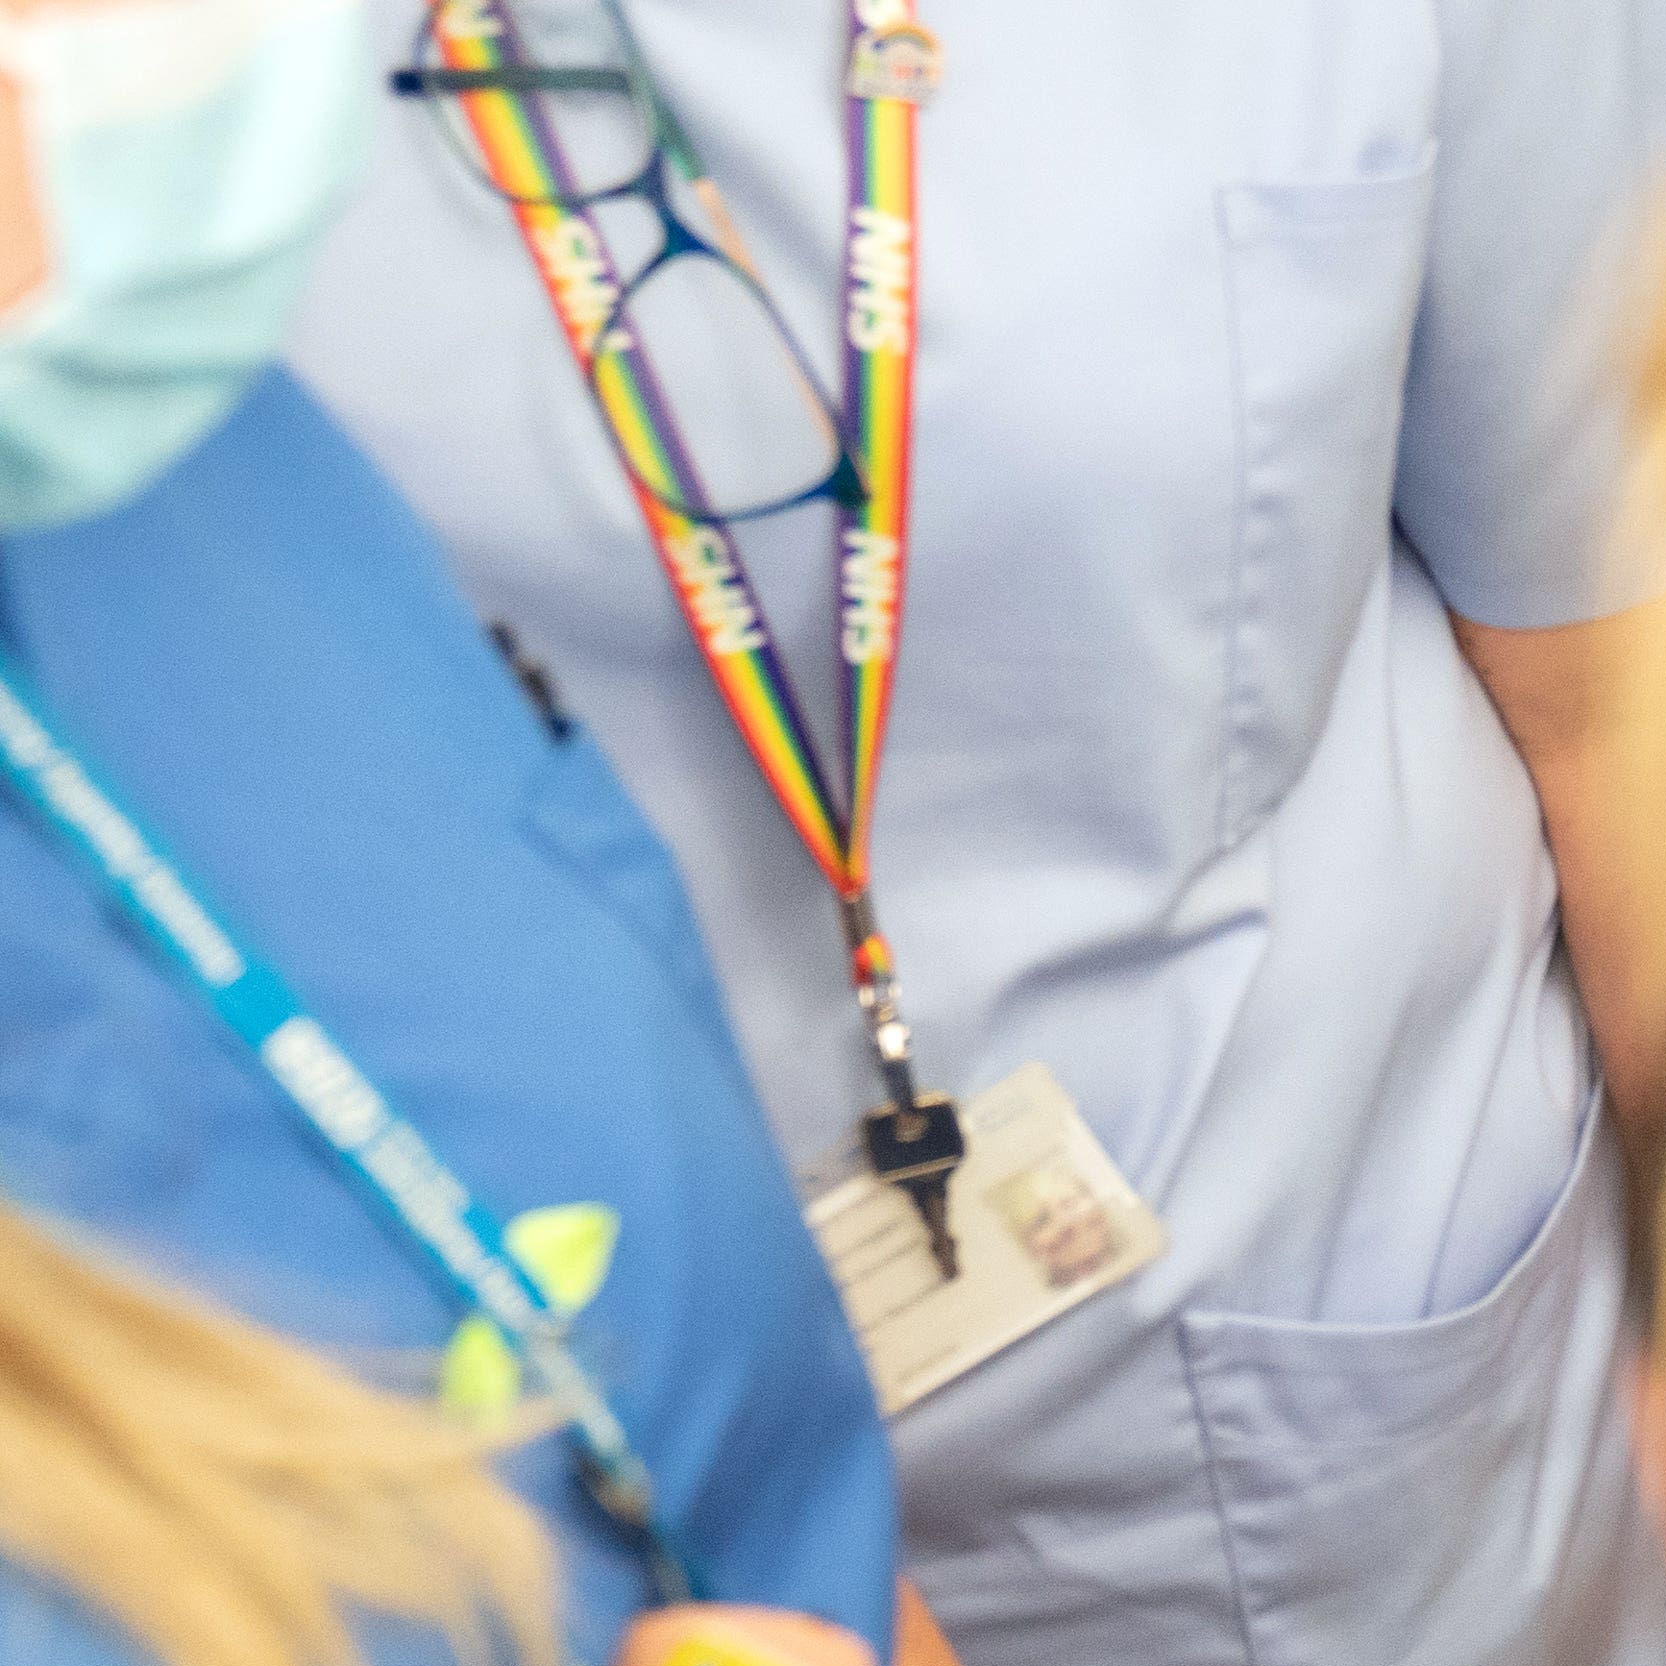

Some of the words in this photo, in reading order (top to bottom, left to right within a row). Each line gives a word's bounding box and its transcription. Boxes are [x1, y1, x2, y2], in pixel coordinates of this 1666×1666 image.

[847, 207, 911, 357] NHS
[664, 525, 766, 654] NHS
[840, 528, 898, 666] NHS
